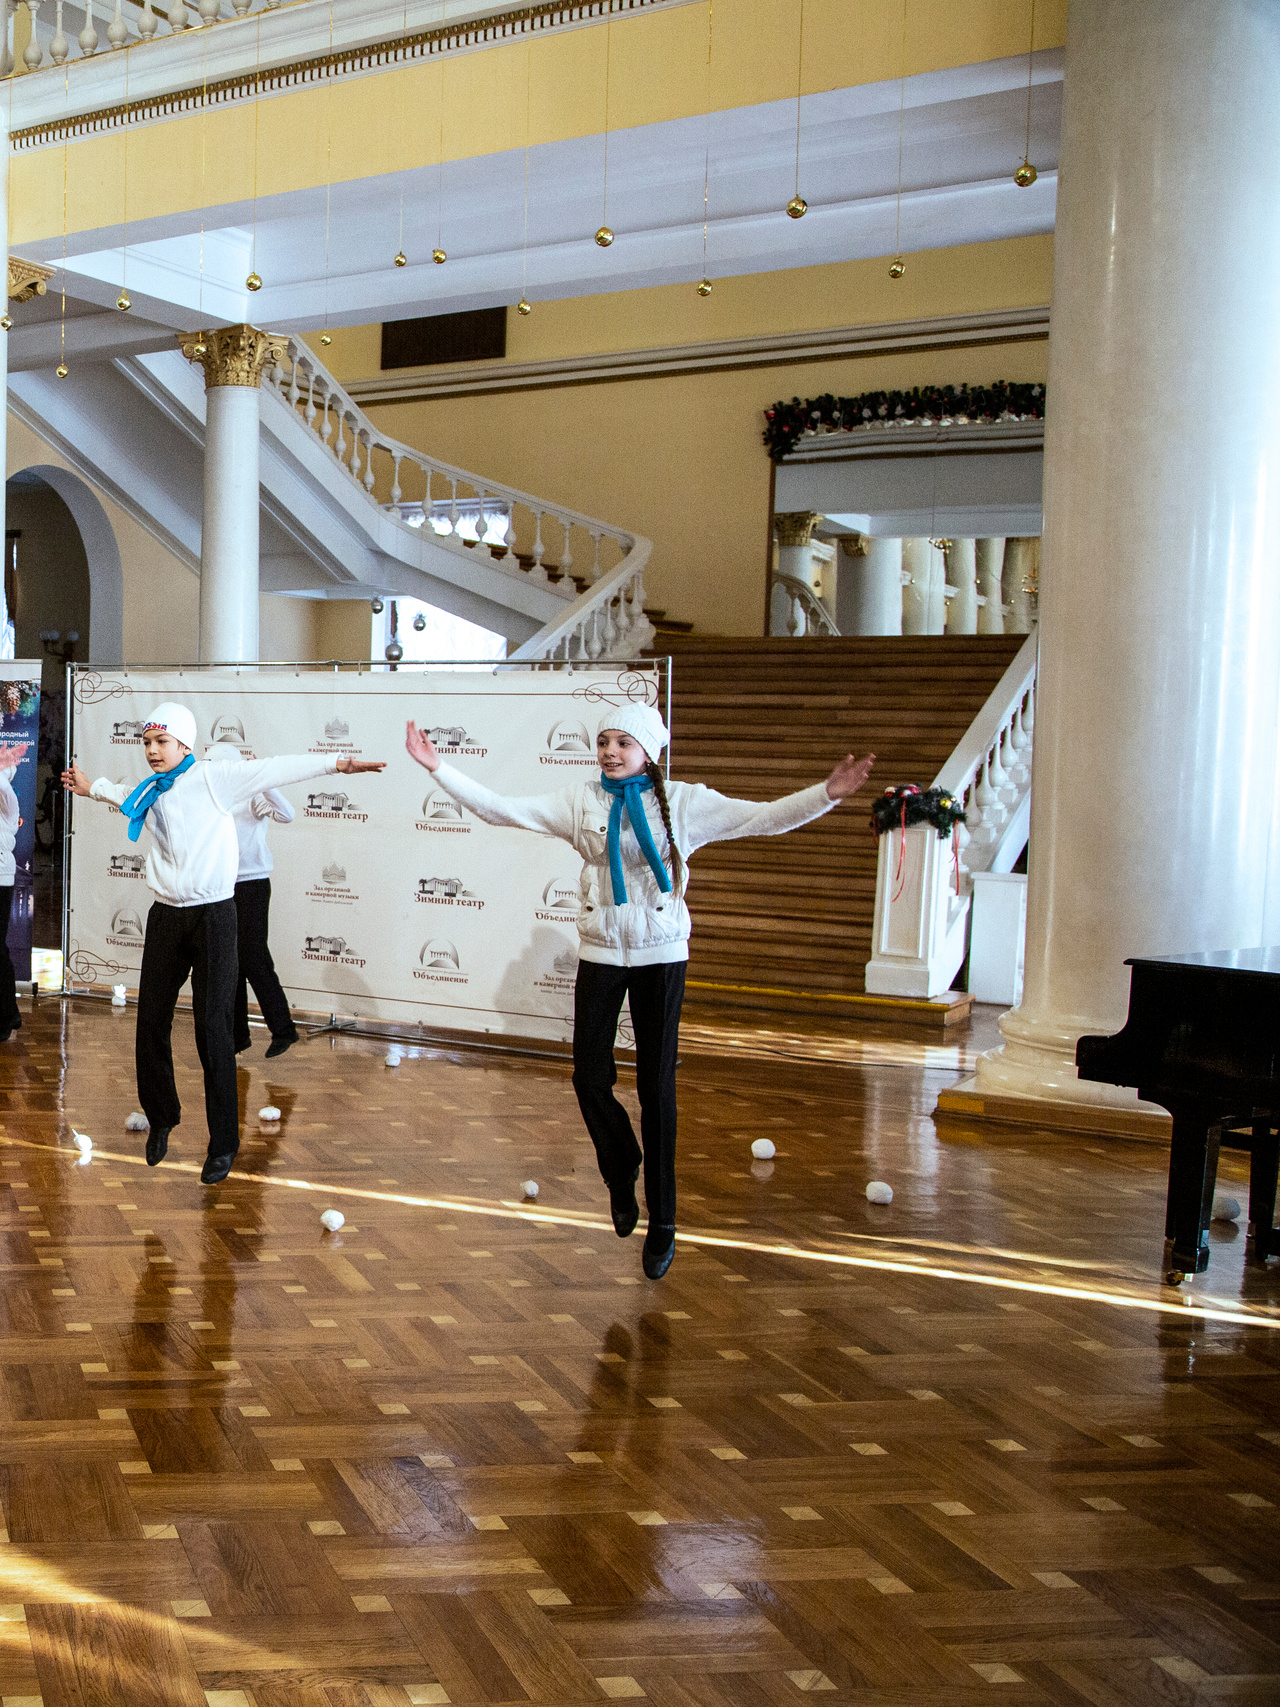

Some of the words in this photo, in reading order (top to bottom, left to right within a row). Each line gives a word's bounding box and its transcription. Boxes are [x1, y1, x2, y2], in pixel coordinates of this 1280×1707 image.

[0, 739, 35, 747] аторсой
[110, 735, 141, 744] Зимний
[459, 747, 488, 758] театр
[303, 807, 341, 819] Зимний
[342, 812, 369, 823] театр
[415, 823, 471, 834] Объединение
[106, 867, 140, 879] Зимний
[414, 892, 454, 904] Зимний
[456, 899, 485, 910] театр
[535, 911, 576, 923] Объедин
[105, 937, 145, 949] Объединен
[301, 950, 338, 962] Зимний
[340, 957, 367, 968] театр
[413, 971, 469, 983] Объединение
